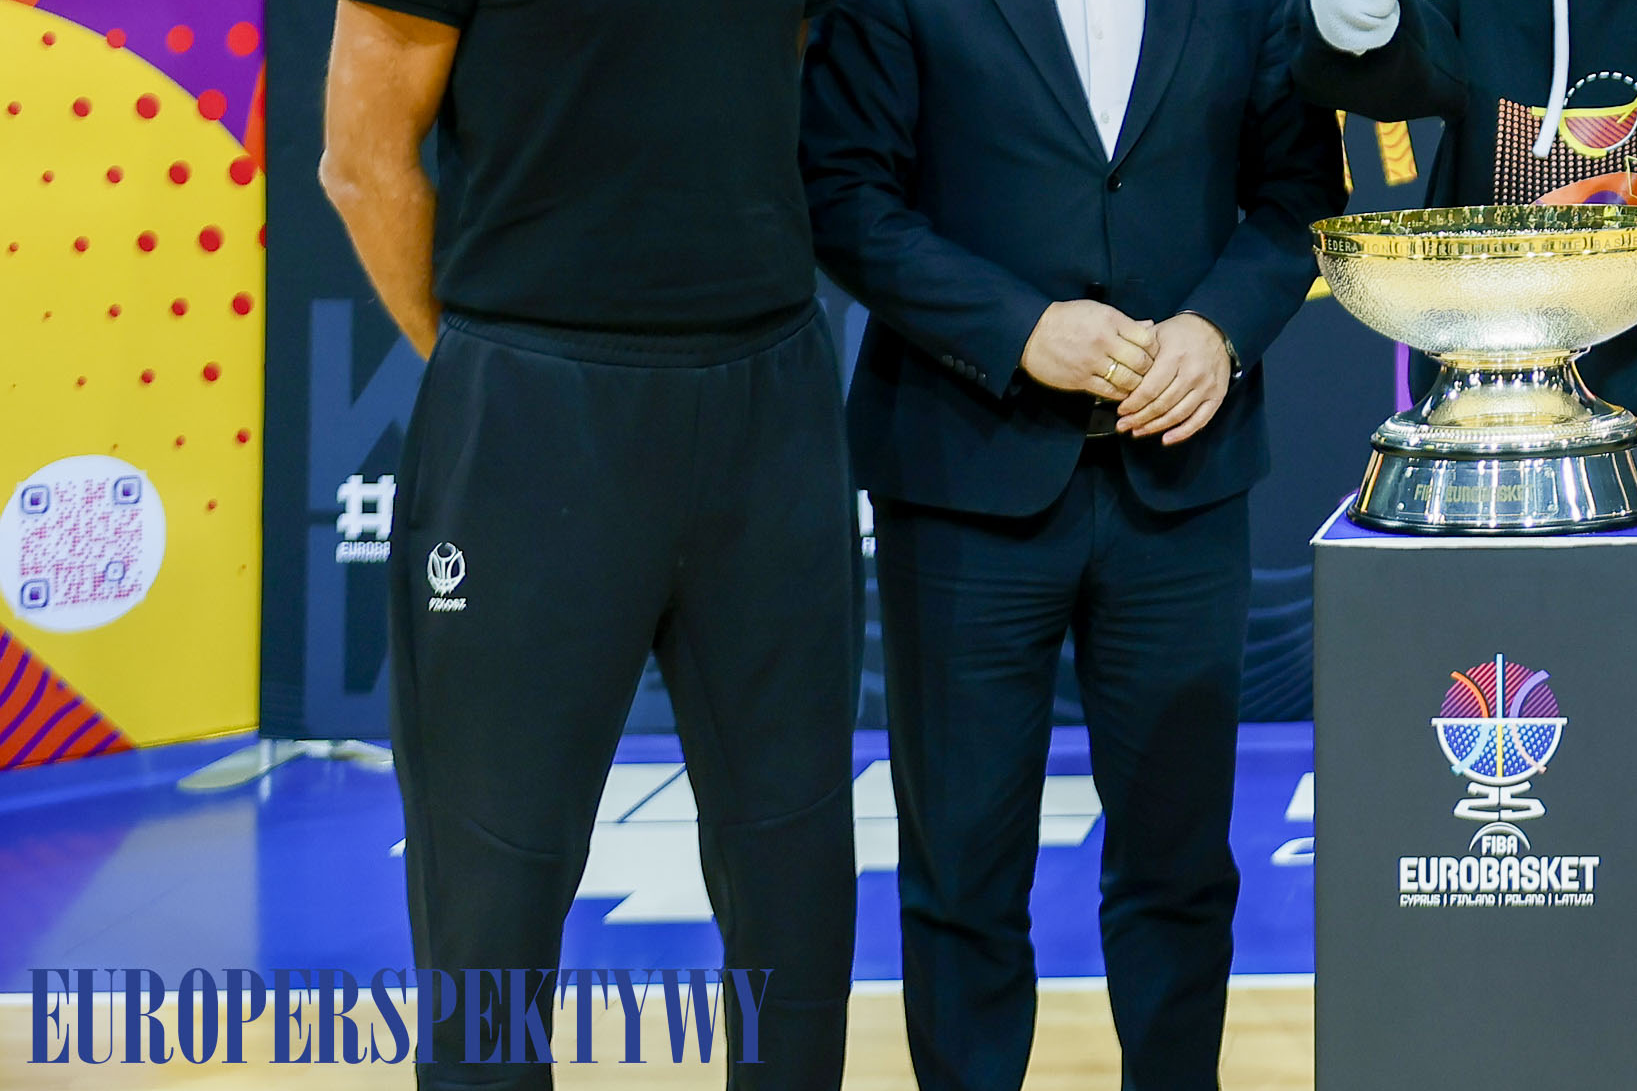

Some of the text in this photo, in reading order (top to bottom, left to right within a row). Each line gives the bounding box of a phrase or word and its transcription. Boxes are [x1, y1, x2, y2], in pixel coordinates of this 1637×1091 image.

[1445, 484, 1534, 503] EUROBSKE
[1481, 835, 1518, 856] FIBA
[1400, 856, 1600, 893] EUROBASKET
[1400, 893, 1594, 907] CYPRUS FINLAND POLAND LATVIA
